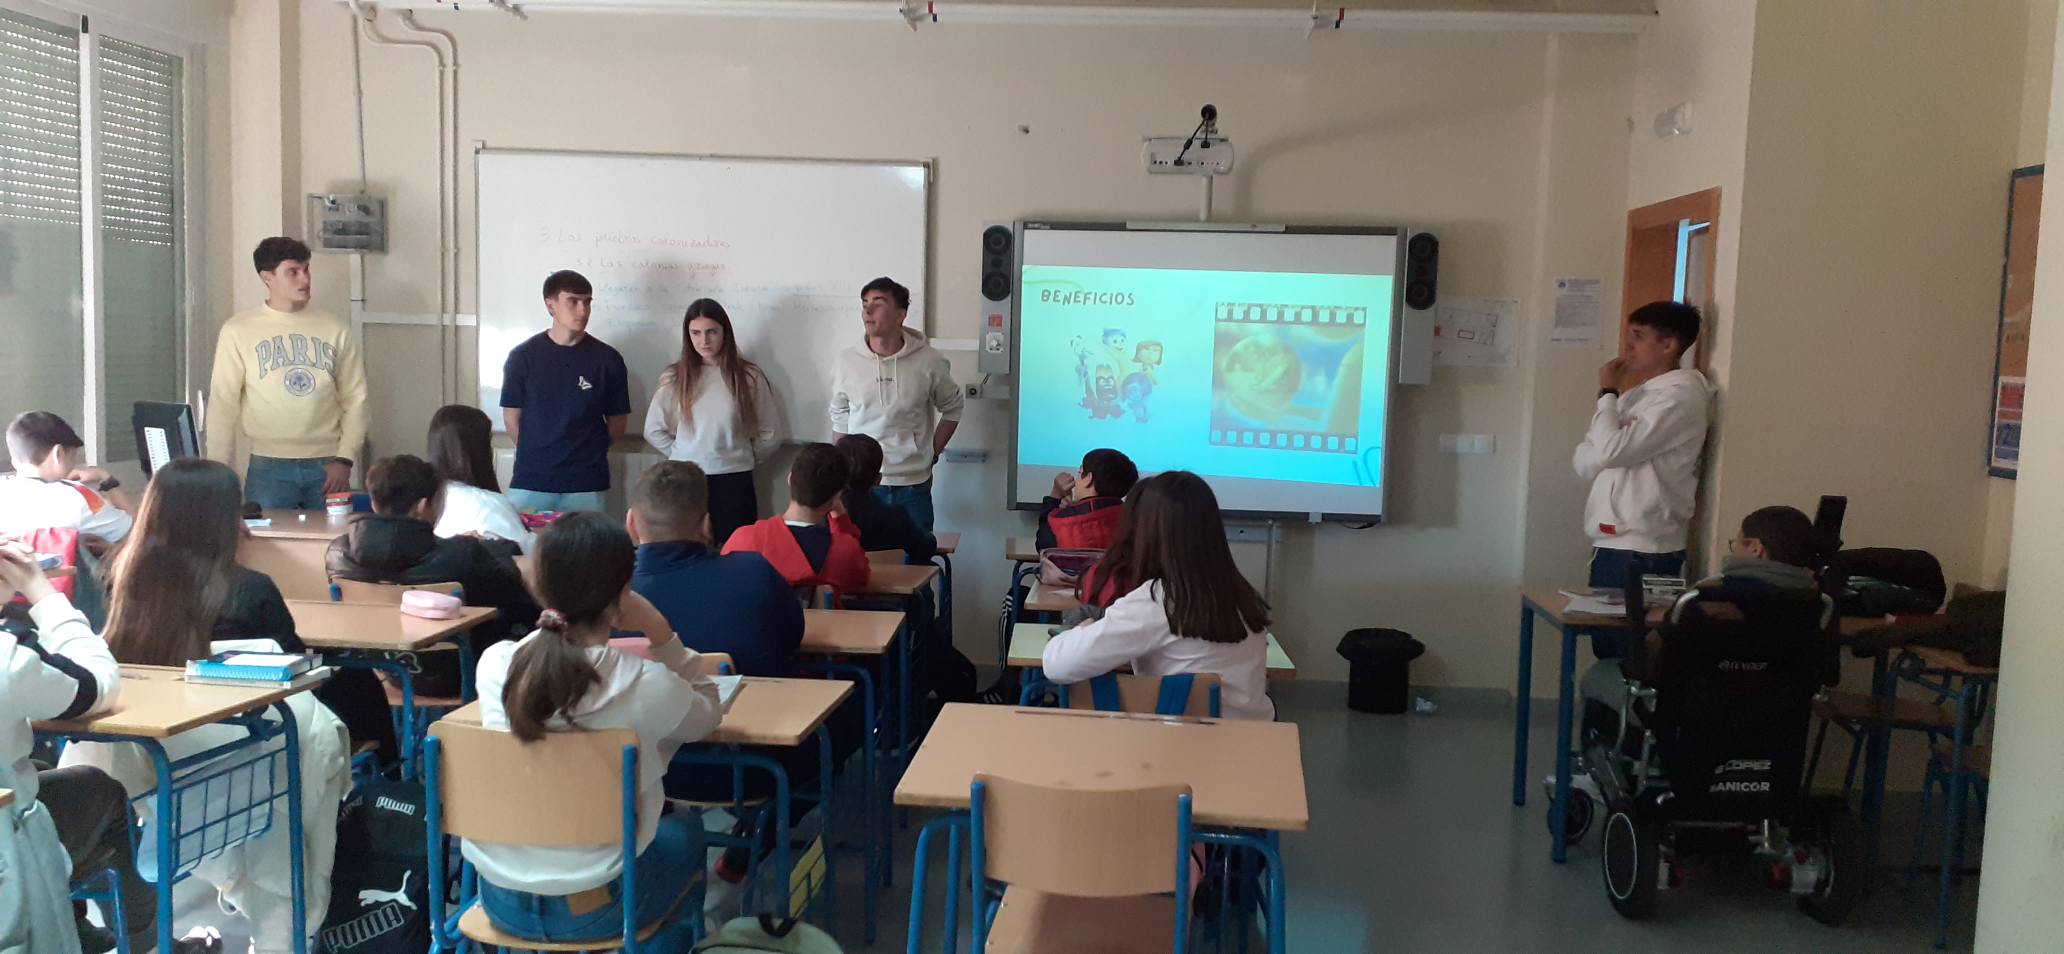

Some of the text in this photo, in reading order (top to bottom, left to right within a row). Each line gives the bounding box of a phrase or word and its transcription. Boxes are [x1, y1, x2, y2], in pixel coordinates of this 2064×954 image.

[1041, 288, 1135, 306] BENEFICIOS
[255, 334, 338, 381] PARIS
[376, 796, 415, 815] PUMA
[323, 901, 404, 953] PUMA
